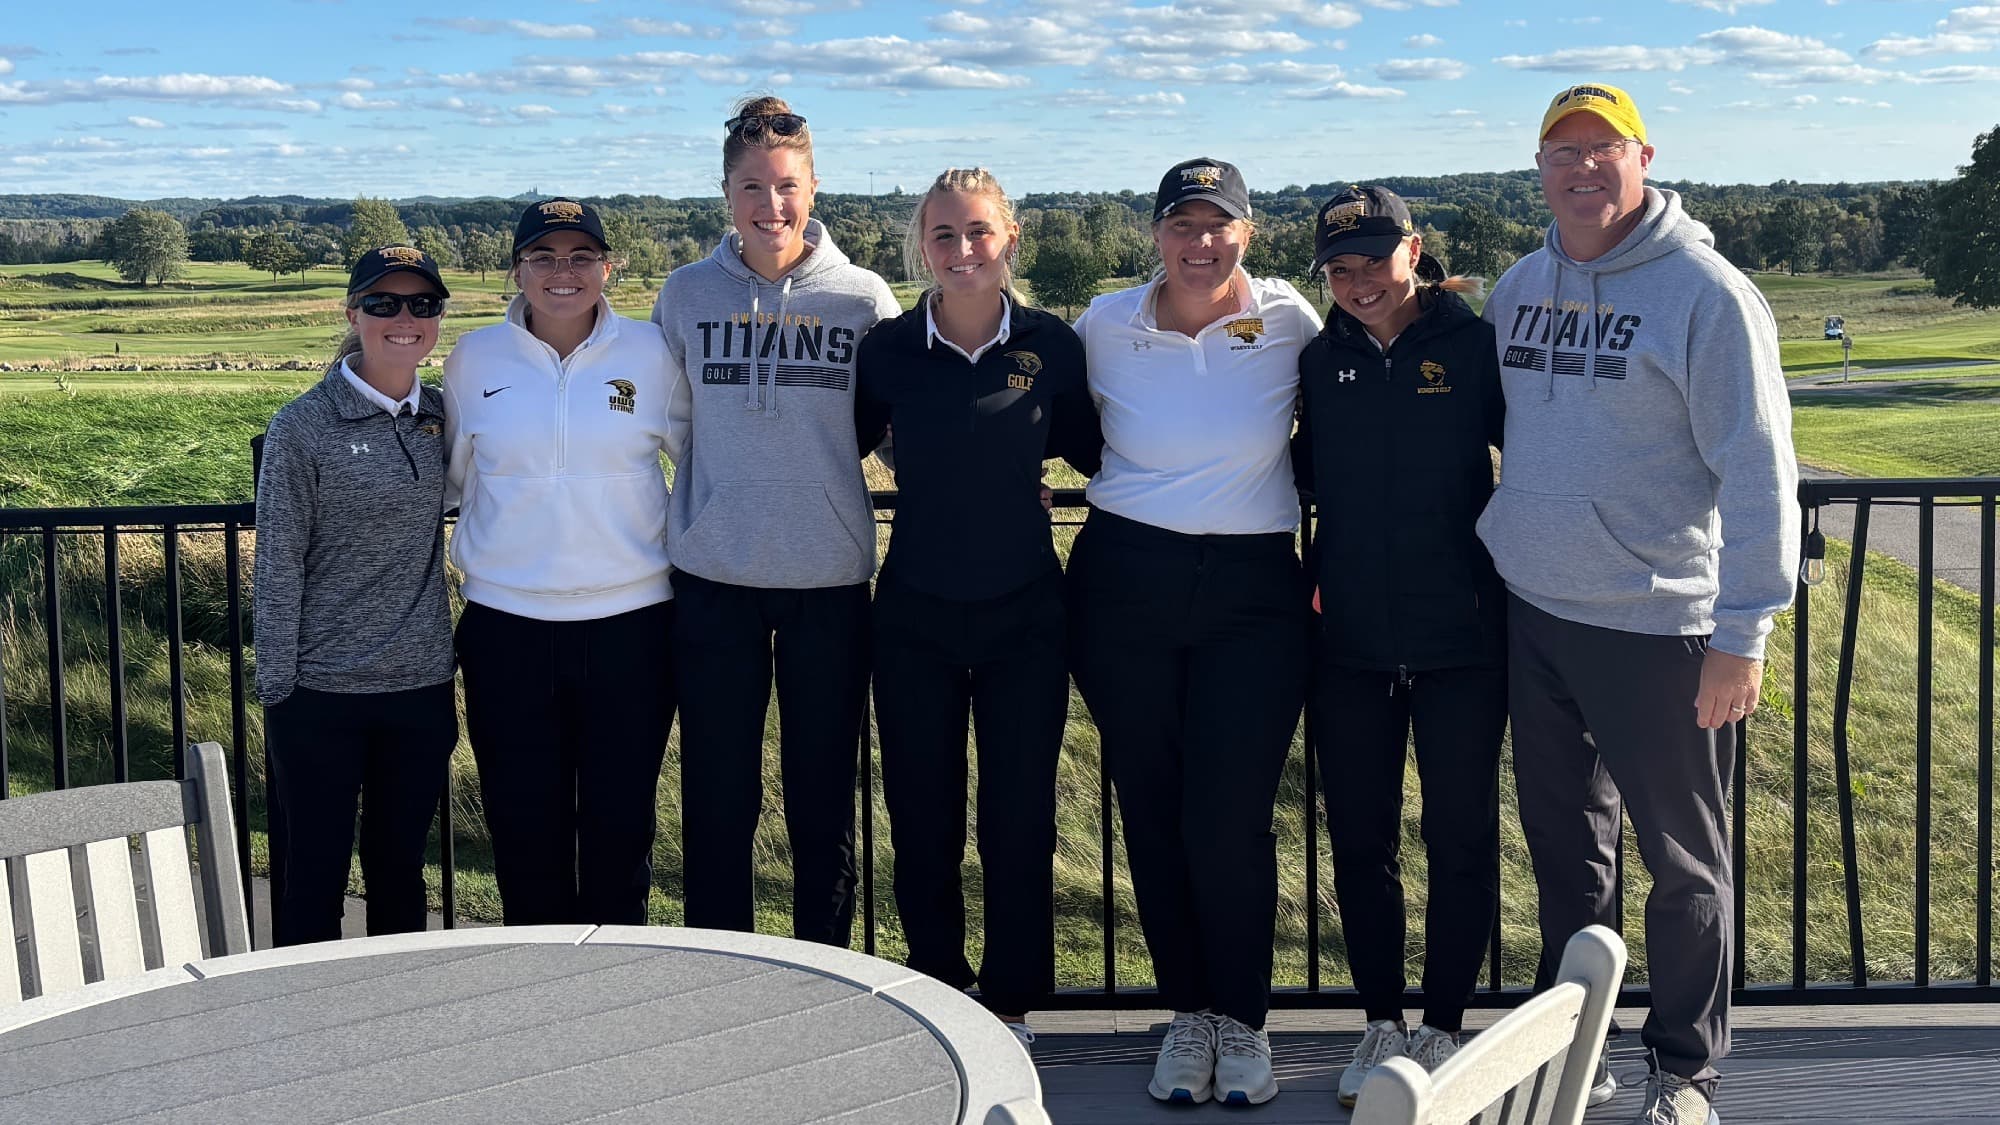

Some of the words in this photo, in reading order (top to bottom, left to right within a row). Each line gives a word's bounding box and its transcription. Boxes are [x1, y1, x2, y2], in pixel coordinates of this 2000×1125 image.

[1573, 86, 1618, 106] OSHKOSH
[1562, 300, 1615, 315] OSHKSH
[730, 311, 750, 325] UW
[1510, 304, 1642, 351] TITANS
[697, 320, 855, 364] TITANS
[1505, 350, 1529, 364] GOLF
[706, 366, 734, 380] GOLF
[1007, 374, 1034, 391] GOLF
[609, 395, 635, 408] UWO
[608, 404, 634, 415] TITANS
